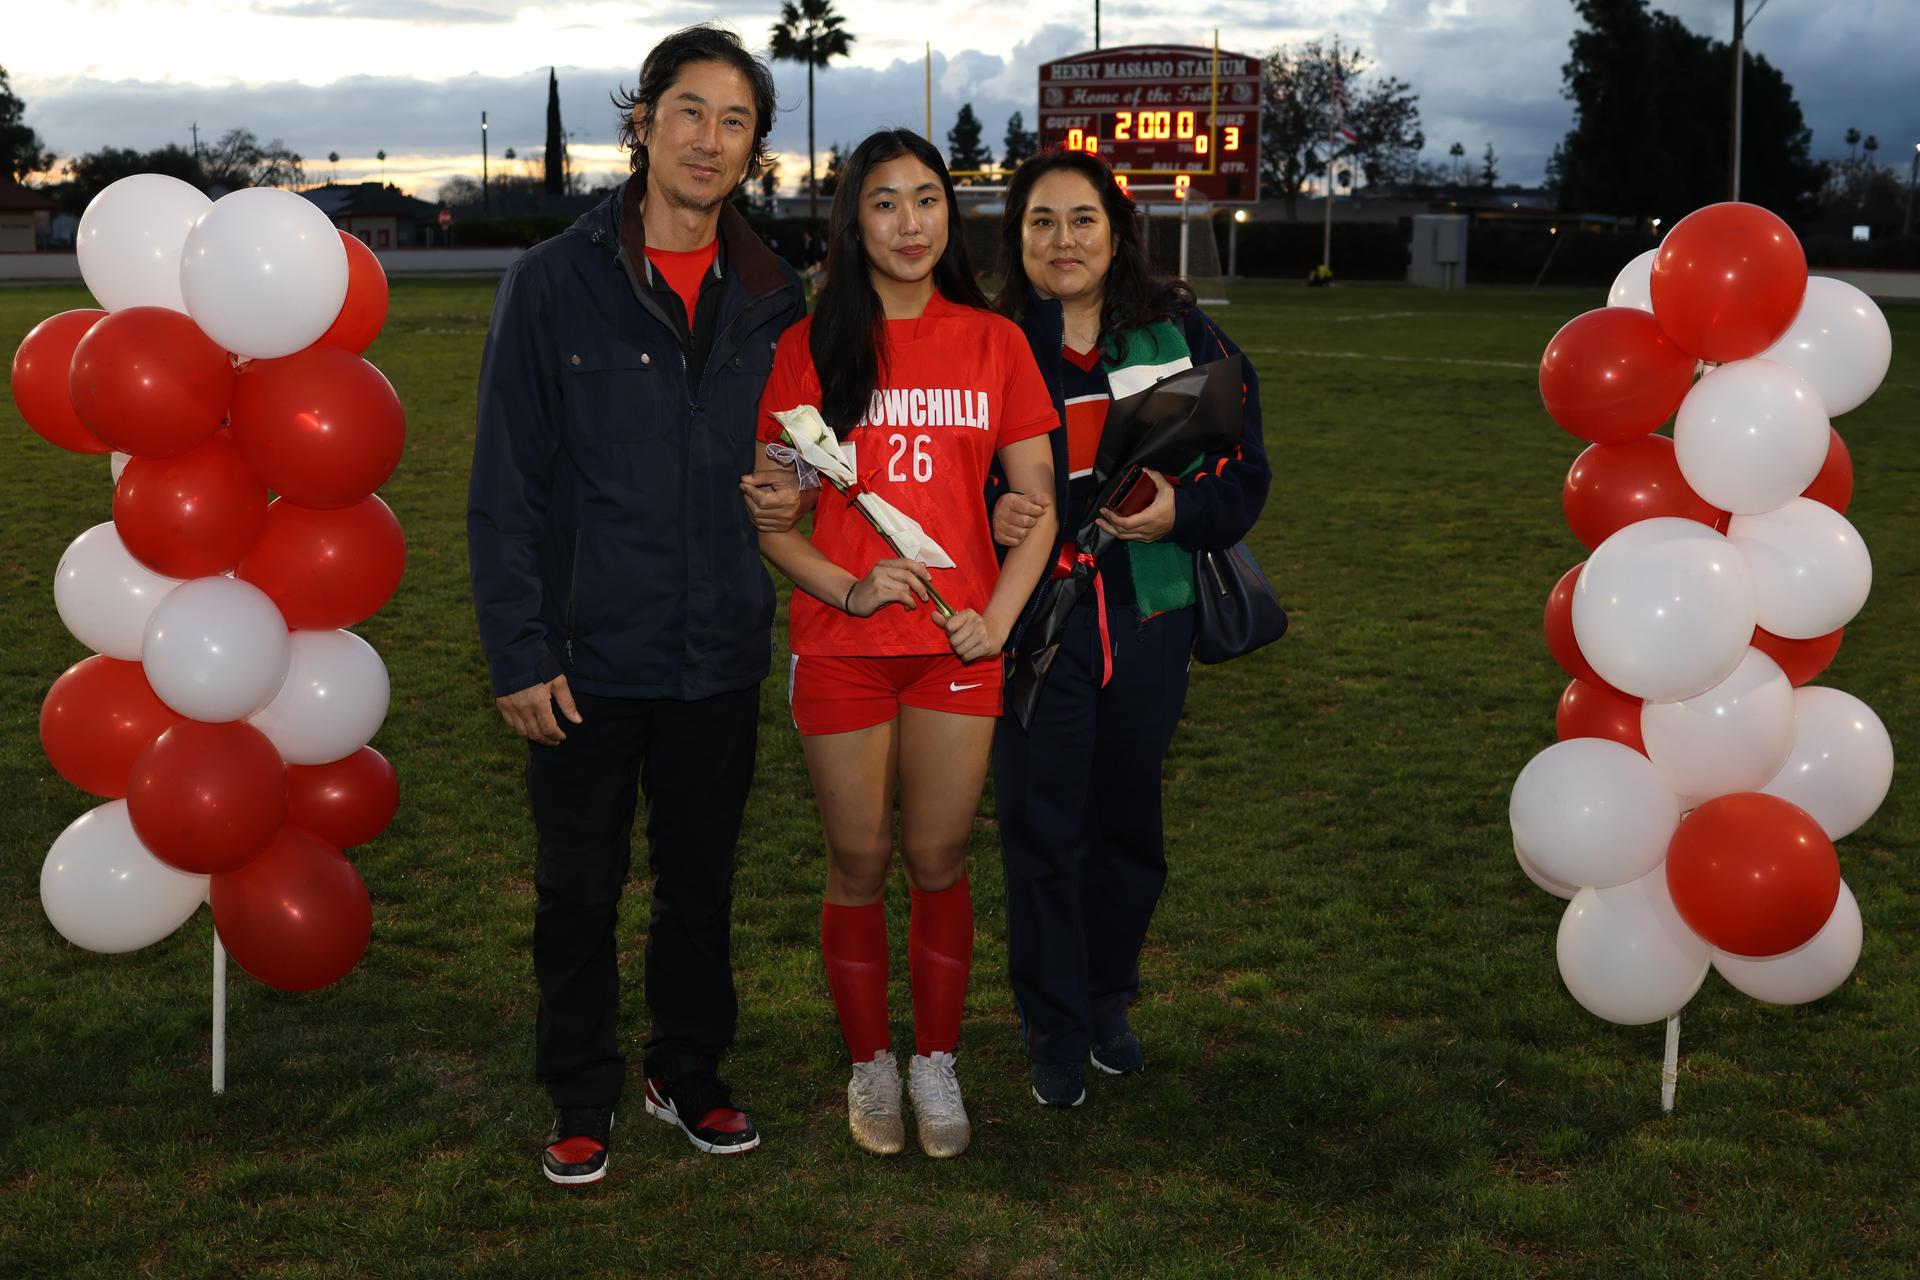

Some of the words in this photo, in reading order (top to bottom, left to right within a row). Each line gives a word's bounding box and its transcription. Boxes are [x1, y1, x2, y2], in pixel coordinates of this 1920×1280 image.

[1051, 63, 1099, 80] HENRY
[1103, 61, 1174, 78] MASSARO
[1177, 60, 1247, 76] STADIUM
[1069, 88, 1119, 104] Home
[1122, 86, 1143, 108] of
[1147, 86, 1172, 103] the
[1176, 86, 1228, 102] Trib!
[1046, 116, 1091, 128] GUEST
[1223, 127, 1239, 150] 3
[857, 388, 989, 431] OWCHILLA
[888, 433, 933, 483] 26
